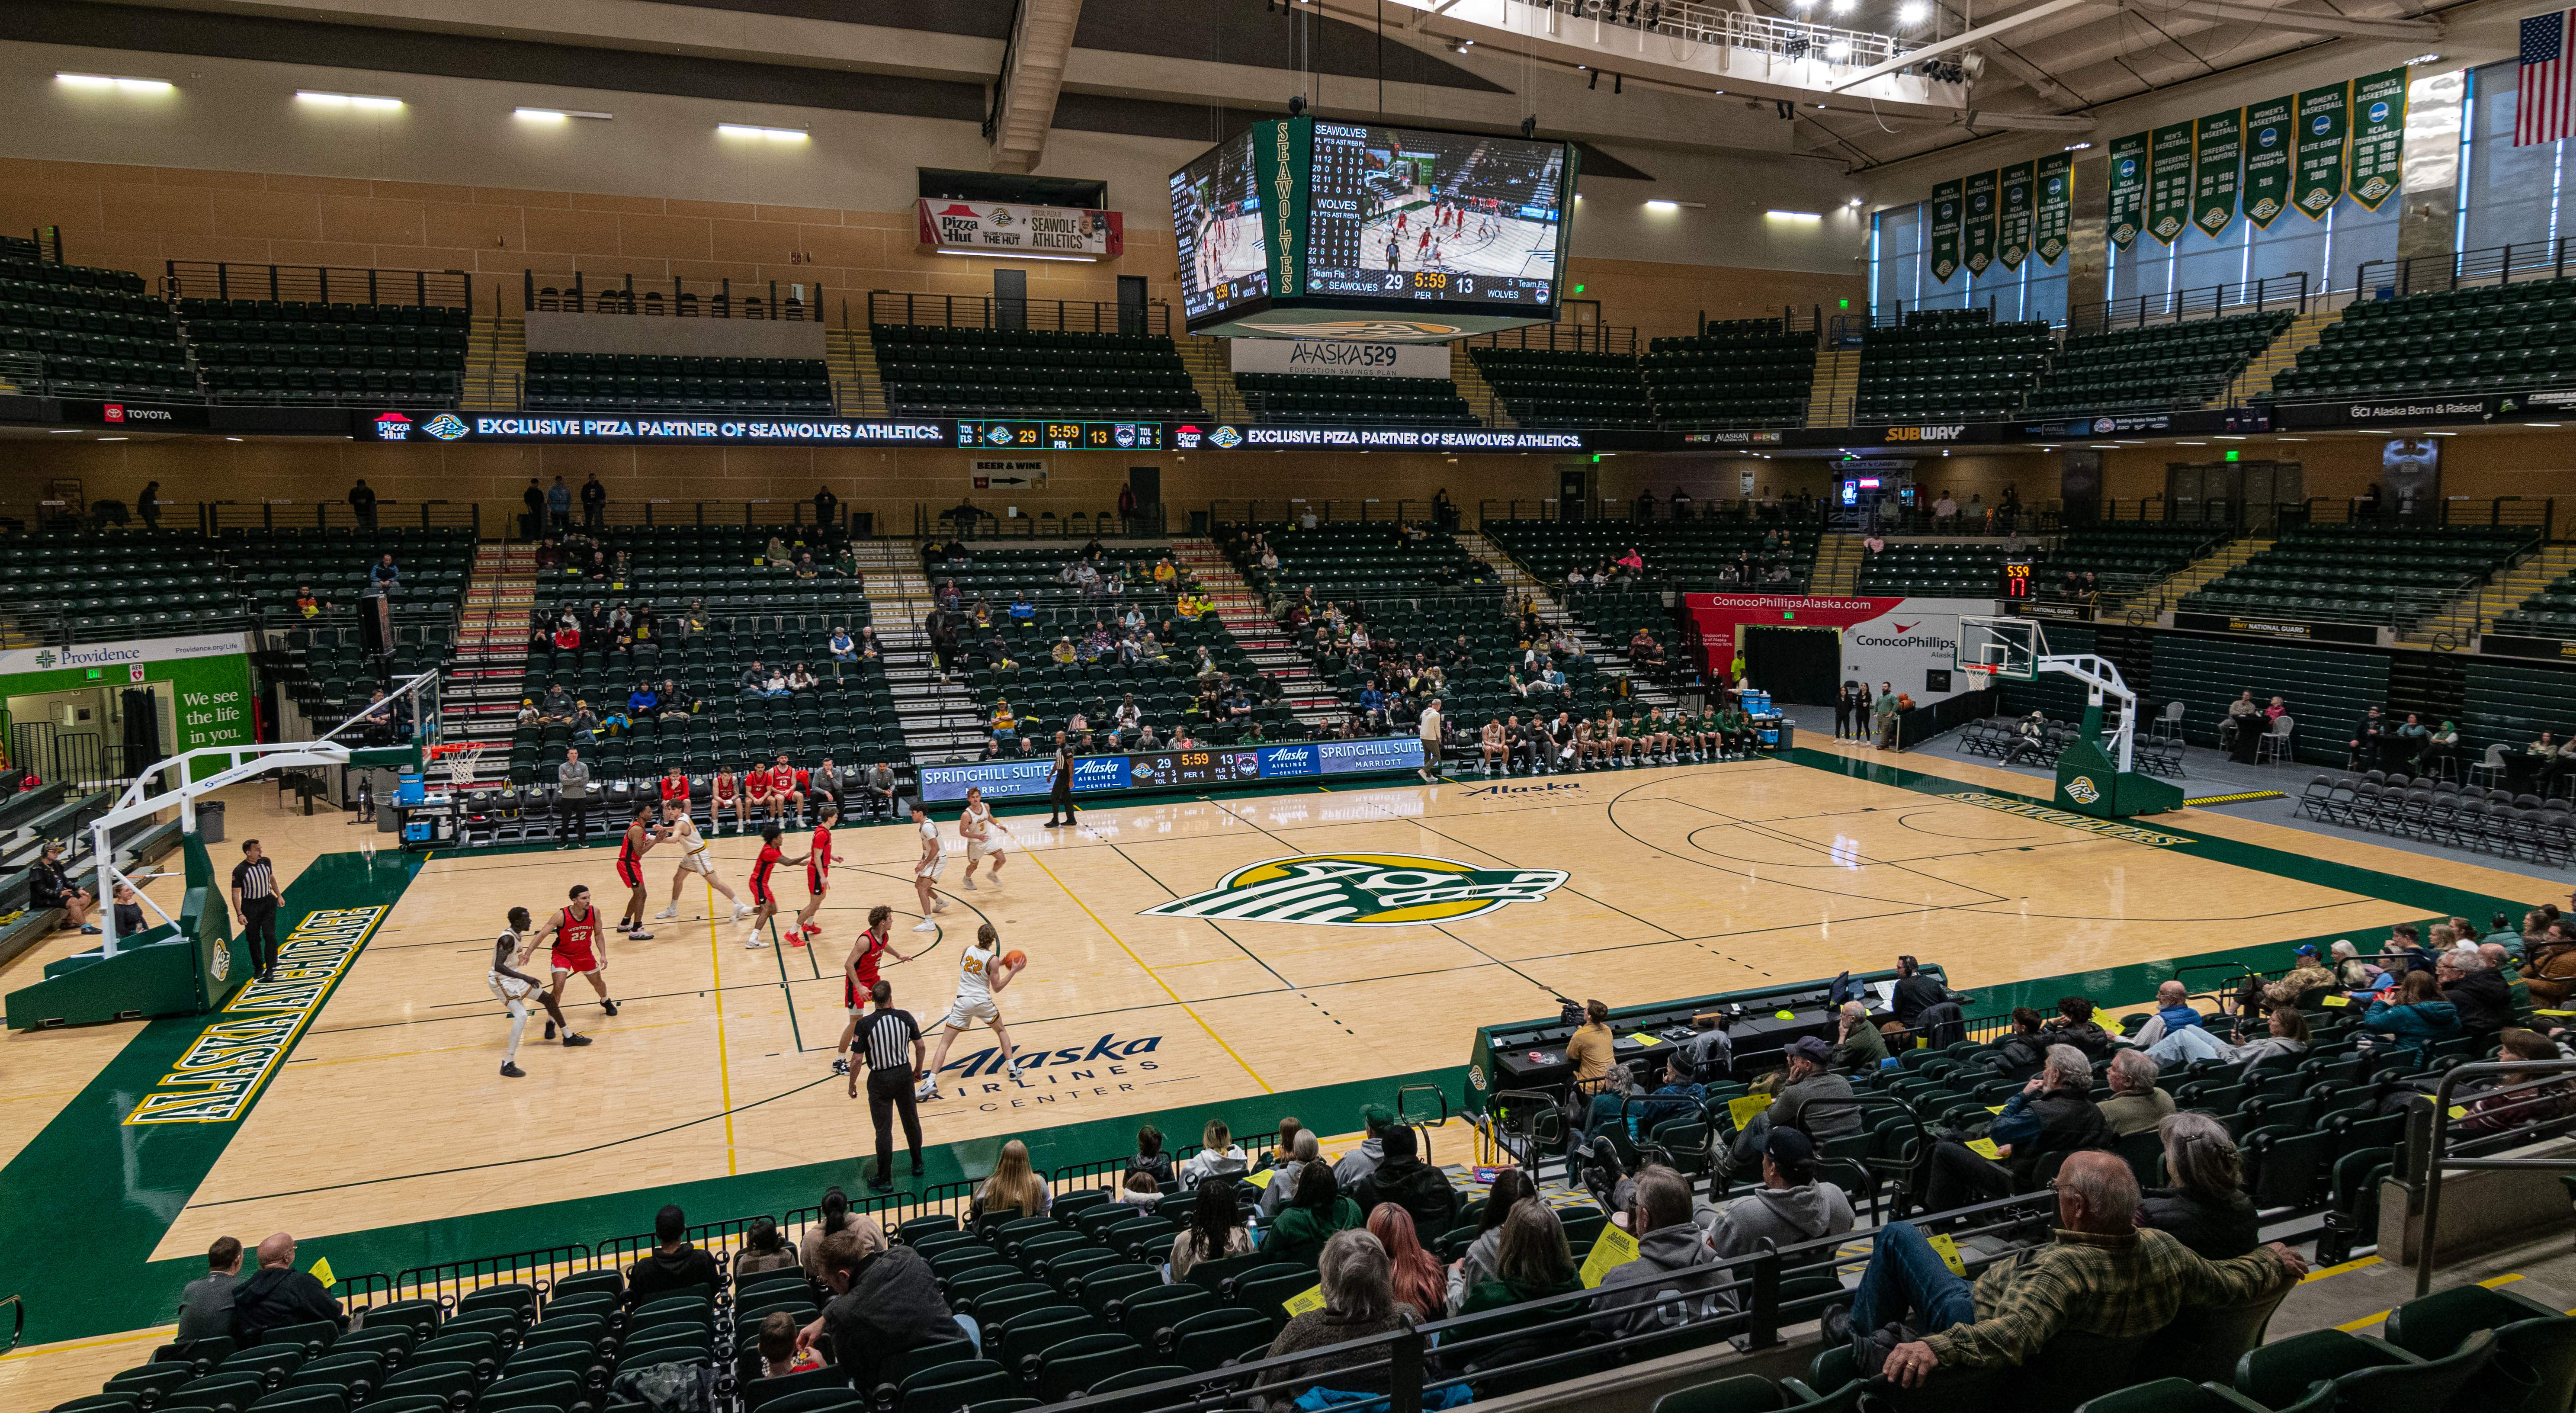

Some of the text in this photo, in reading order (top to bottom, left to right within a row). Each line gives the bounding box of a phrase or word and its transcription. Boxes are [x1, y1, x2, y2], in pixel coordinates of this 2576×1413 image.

[2363, 78, 2396, 92] WOMEN'S
[2356, 86, 2402, 102] BASKETBALL
[2301, 100, 2343, 116] BASKETBALL
[1315, 125, 1367, 138] SEAWOLVES
[2367, 125, 2387, 134] NCAA
[2355, 129, 2401, 145] TOURNAMENT
[2201, 142, 2238, 156] CONFERENCE
[2300, 138, 2342, 152] ELITE EIGHT
[2201, 151, 2237, 164] CHAMPIONS
[2249, 157, 2286, 170] RUNNER-UP
[2252, 151, 2284, 162] NATIONAL
[1274, 122, 1293, 294] SEAWOLVES
[1317, 199, 1357, 210] WOLVES
[942, 217, 978, 230] Pizza
[1032, 218, 1076, 234] SEAWOLF
[943, 228, 972, 243] Hut
[983, 235, 1020, 246] THE HUT
[1033, 233, 1082, 249] ATHLETICS
[1312, 270, 1332, 278] Team
[1334, 270, 1344, 278] Fls
[1415, 272, 1446, 288] 5:59
[1329, 282, 1378, 292] SEAWOLVES
[1385, 274, 1403, 290] 29
[1456, 278, 1473, 293] 13
[1518, 279, 1536, 288] Team
[1537, 280, 1548, 288] Fls
[1488, 290, 1519, 299] WOLVES
[1290, 343, 1396, 366] ALASKA529
[127, 410, 172, 420] TOYOTA
[2351, 402, 2483, 417] GCI Alaska Born & Raised
[378, 421, 411, 432] Pizza
[478, 419, 943, 440] EXCLUSIVE PIZZA PARTNER OF SEAWOLVES ATHLETICS.
[1049, 425, 1079, 438] 5:59
[1019, 430, 1036, 443] 29
[1091, 431, 1107, 443] 13
[1177, 433, 1201, 441] Pizza
[1248, 430, 1581, 447] EXCLUSIVE PIZZA PARTNER OF SEAWOLVES ATHLETICS.
[1715, 433, 1749, 443] ALASKAN
[1885, 425, 1965, 443] SUBWAY
[977, 462, 1004, 470] BEER
[2008, 566, 2029, 577] 5:59
[1713, 597, 1871, 609] ConocoPhillipsAlaska.com
[175, 643, 237, 653] Providence.org/Life
[1857, 635, 1956, 650] ConocoPhillips
[61, 648, 140, 665] Providence
[88, 669, 99, 678] EXIT
[183, 692, 238, 706] We see
[186, 706, 240, 726] the life
[191, 728, 241, 745] in you.
[1268, 748, 1309, 761] Alaska
[1322, 742, 1424, 758] SPRINGHILL SUITE
[1157, 758, 1171, 769] 29
[1182, 753, 1209, 766] 5:59
[1220, 755, 1233, 764] 13
[1356, 759, 1401, 768] MARRIOTT
[1074, 760, 1119, 774] Alaska
[925, 768, 1008, 784] SPRINGHILL
[966, 784, 1021, 794] RRIOTT
[1458, 783, 1581, 796] Alaska
[1944, 793, 2197, 845] SEAWOLVES
[571, 931, 587, 941] 22
[964, 955, 983, 976] 22
[122, 905, 388, 1125] ALASKA ANCHORAGE
[921, 1033, 1162, 1079] Alaska
[980, 1083, 1133, 1111] CENTER
[1607, 1235, 1630, 1252] ANCHORAGE
[1611, 1231, 1630, 1246] ALASKA
